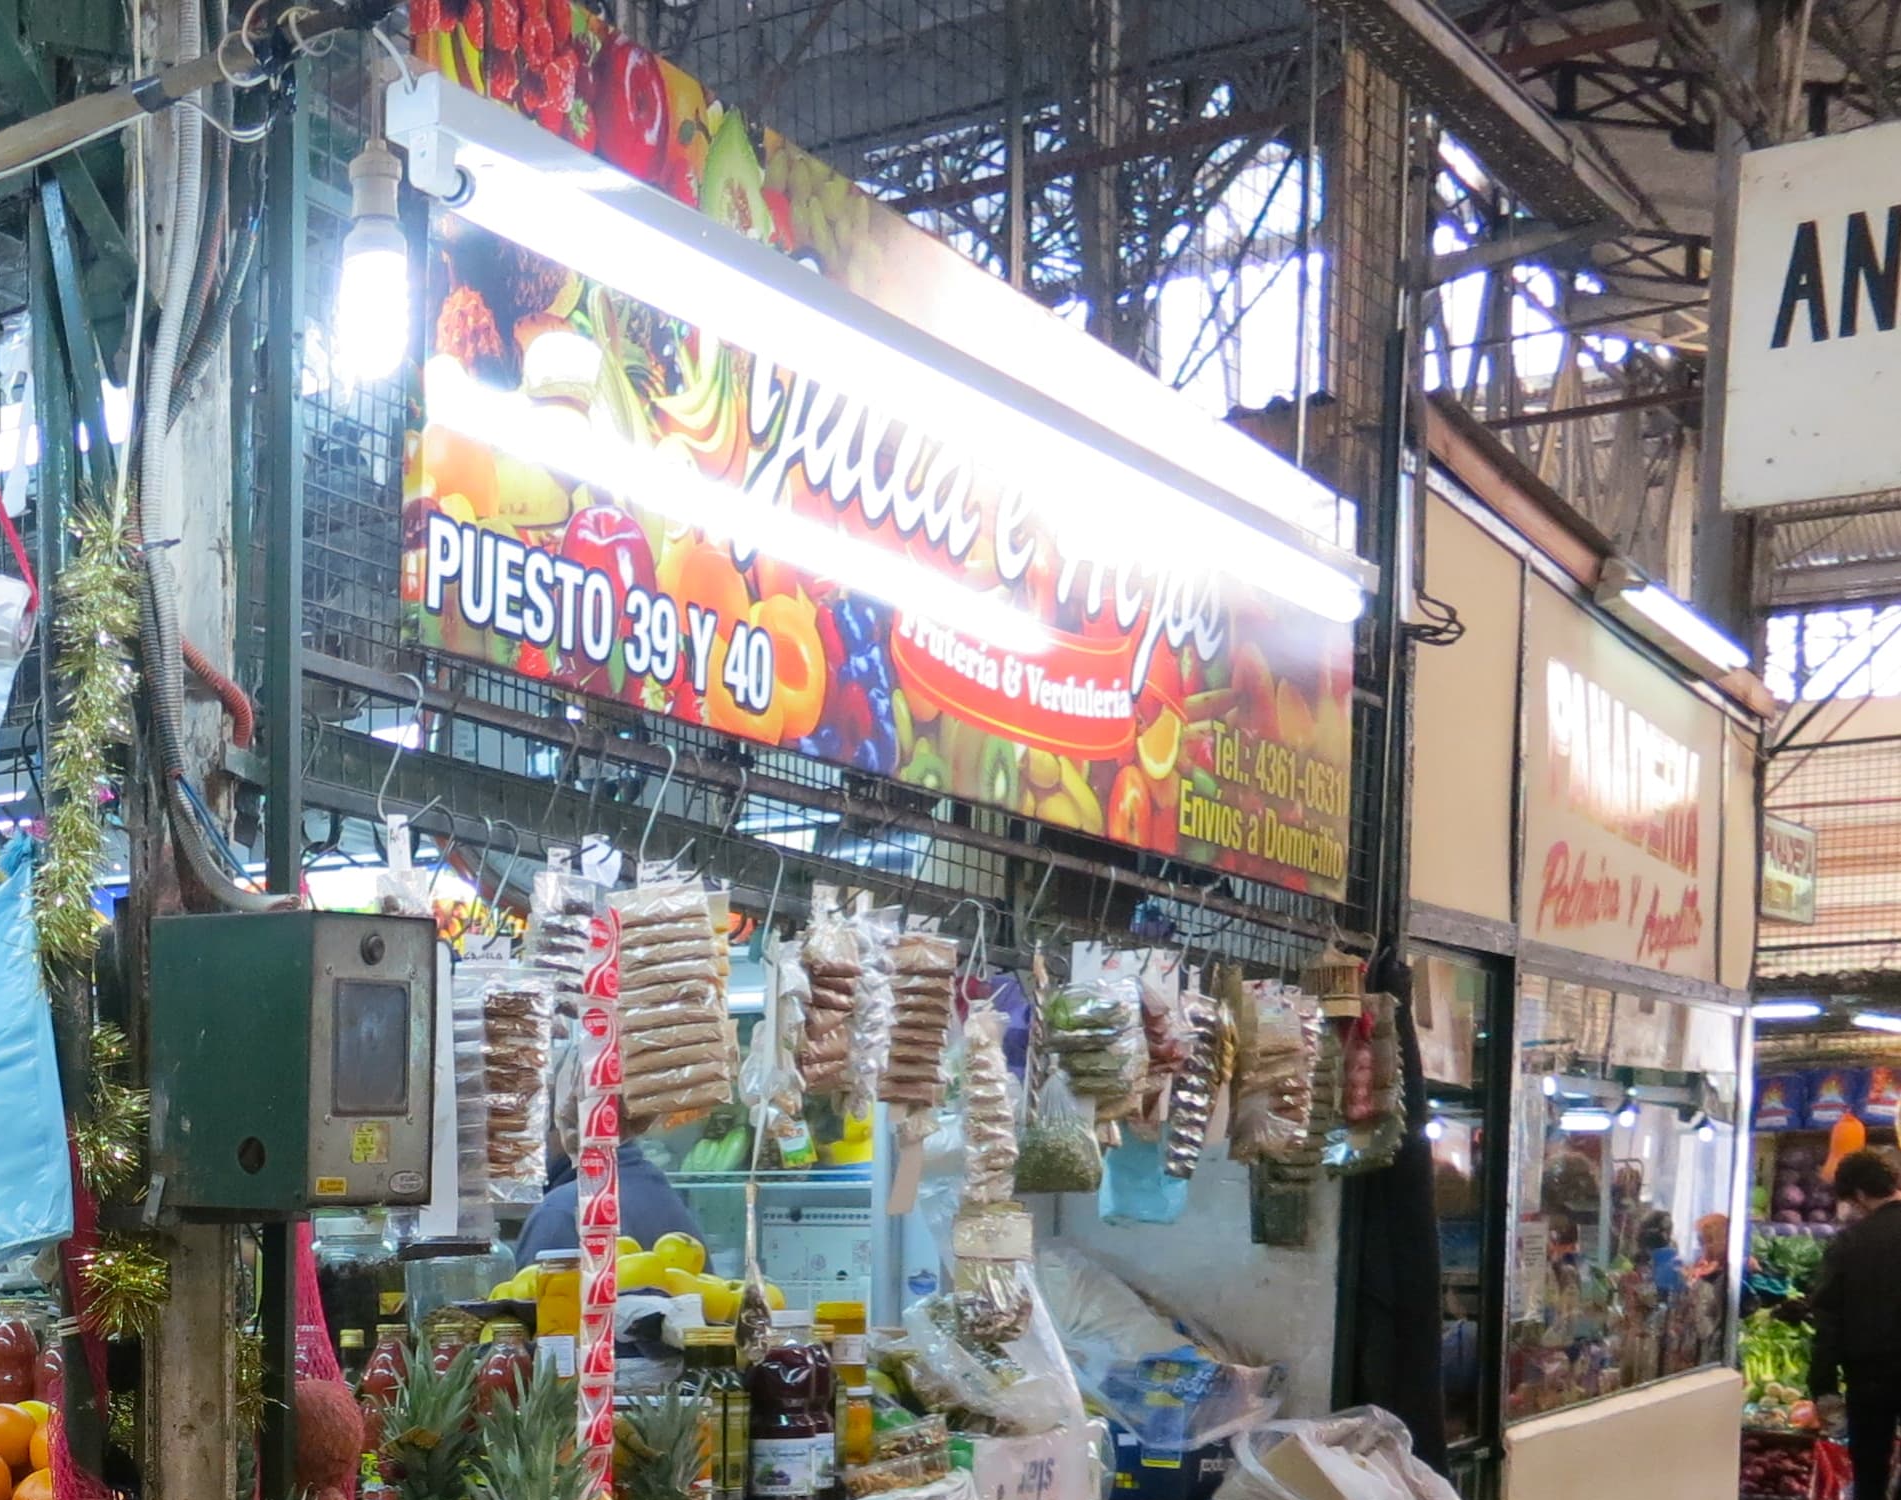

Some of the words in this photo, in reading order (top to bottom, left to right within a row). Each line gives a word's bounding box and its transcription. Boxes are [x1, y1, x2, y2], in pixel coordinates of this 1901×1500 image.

[426, 512, 615, 666] PUESTO
[623, 587, 679, 684] 39
[687, 601, 719, 696] Y
[722, 619, 775, 715] 40
[1002, 655, 1025, 699] &
[1254, 749, 1348, 818] 4361-0631
[1178, 776, 1245, 846] Envíos
[1245, 811, 1259, 855] a
[1264, 807, 1345, 880] Domicilio
